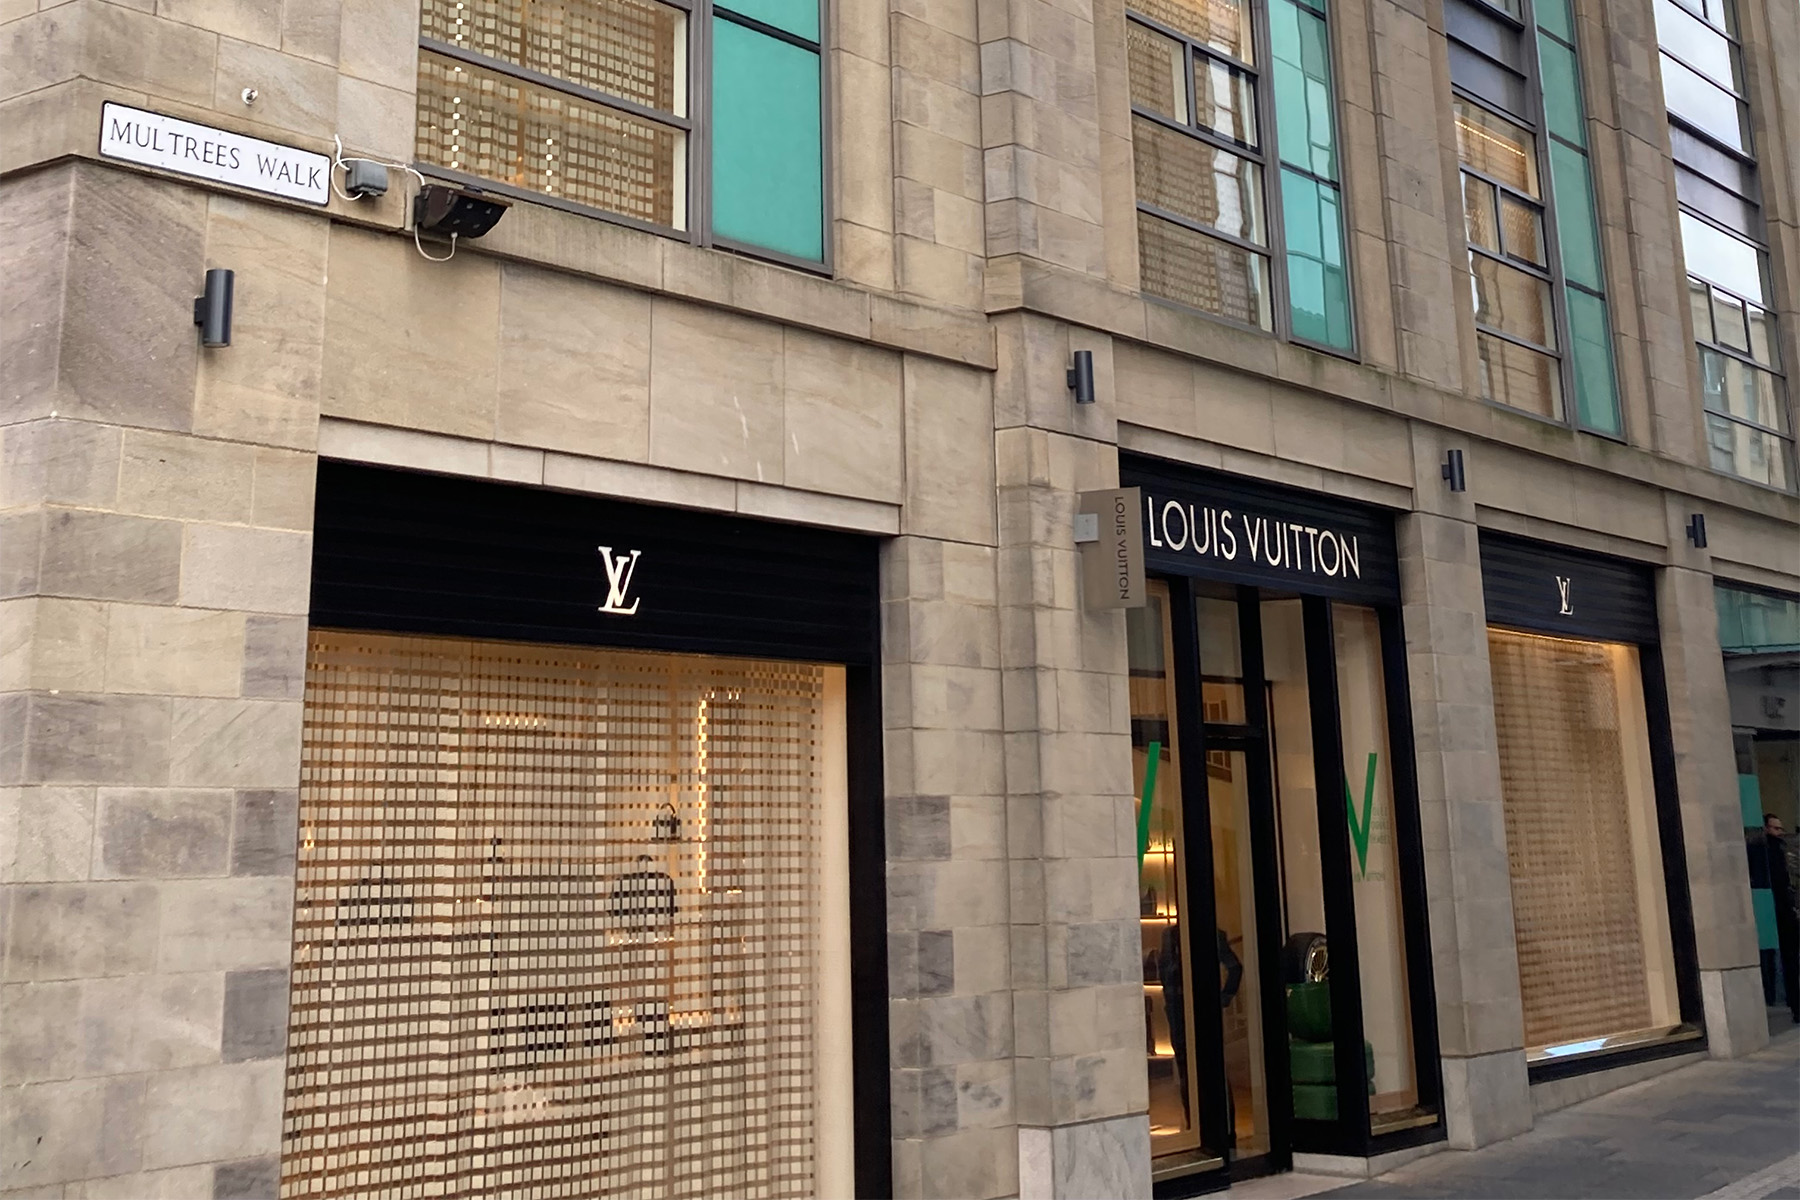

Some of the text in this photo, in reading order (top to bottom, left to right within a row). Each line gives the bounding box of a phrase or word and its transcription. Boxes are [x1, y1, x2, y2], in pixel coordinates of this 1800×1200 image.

[110, 118, 321, 189] MULTREES WALK
[1114, 496, 1130, 600] LOUIS VUITTON
[1147, 496, 1361, 580] LOUIS VUITTON
[597, 545, 642, 615] LV
